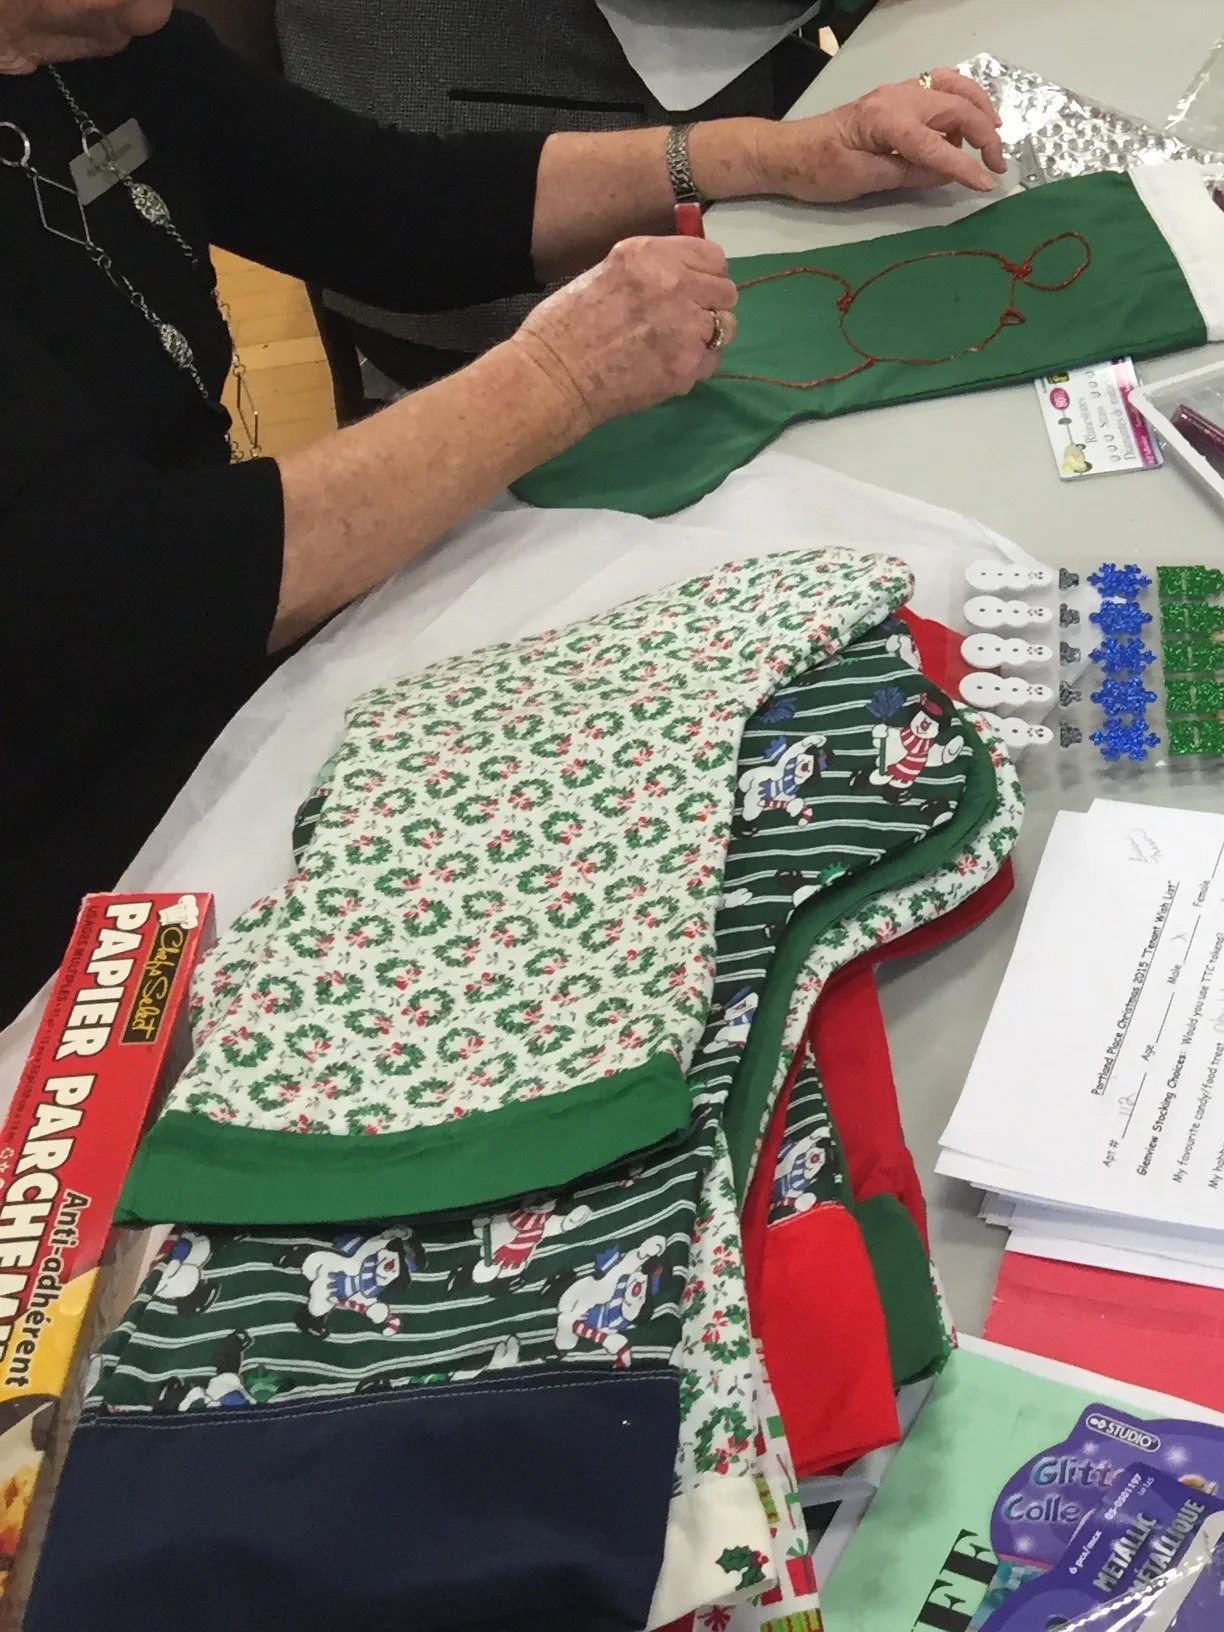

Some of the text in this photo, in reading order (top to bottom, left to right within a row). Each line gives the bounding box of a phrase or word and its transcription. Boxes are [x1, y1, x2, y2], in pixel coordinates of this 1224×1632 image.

[1191, 879, 1211, 907] Female
[53, 901, 153, 1061] PAPIER
[1166, 964, 1182, 985] Male
[1199, 964, 1215, 982] TTC
[1090, 1056, 1115, 1095] Portland
[1105, 1032, 1124, 1055] Place
[1115, 986, 1141, 1028] Christmas
[1131, 960, 1149, 984] 2015
[1153, 902, 1171, 922] Wish
[1197, 984, 1210, 1000] use
[1191, 1000, 1204, 1017] you
[1179, 1016, 1199, 1045] Would
[1140, 1043, 1156, 1061] Age
[1151, 1091, 1177, 1132] Stocking
[1171, 1041, 1224, 1183] My favourite candy/food treat
[1101, 1149, 1117, 1168] Apt
[1135, 1135, 1159, 1175] Glenview
[1206, 1173, 1223, 1189] My
[4, 1189, 91, 1388] Anti-adhérent
[1106, 1423, 1152, 1448] STUDIO
[1093, 1511, 1156, 1593] METALLIC
